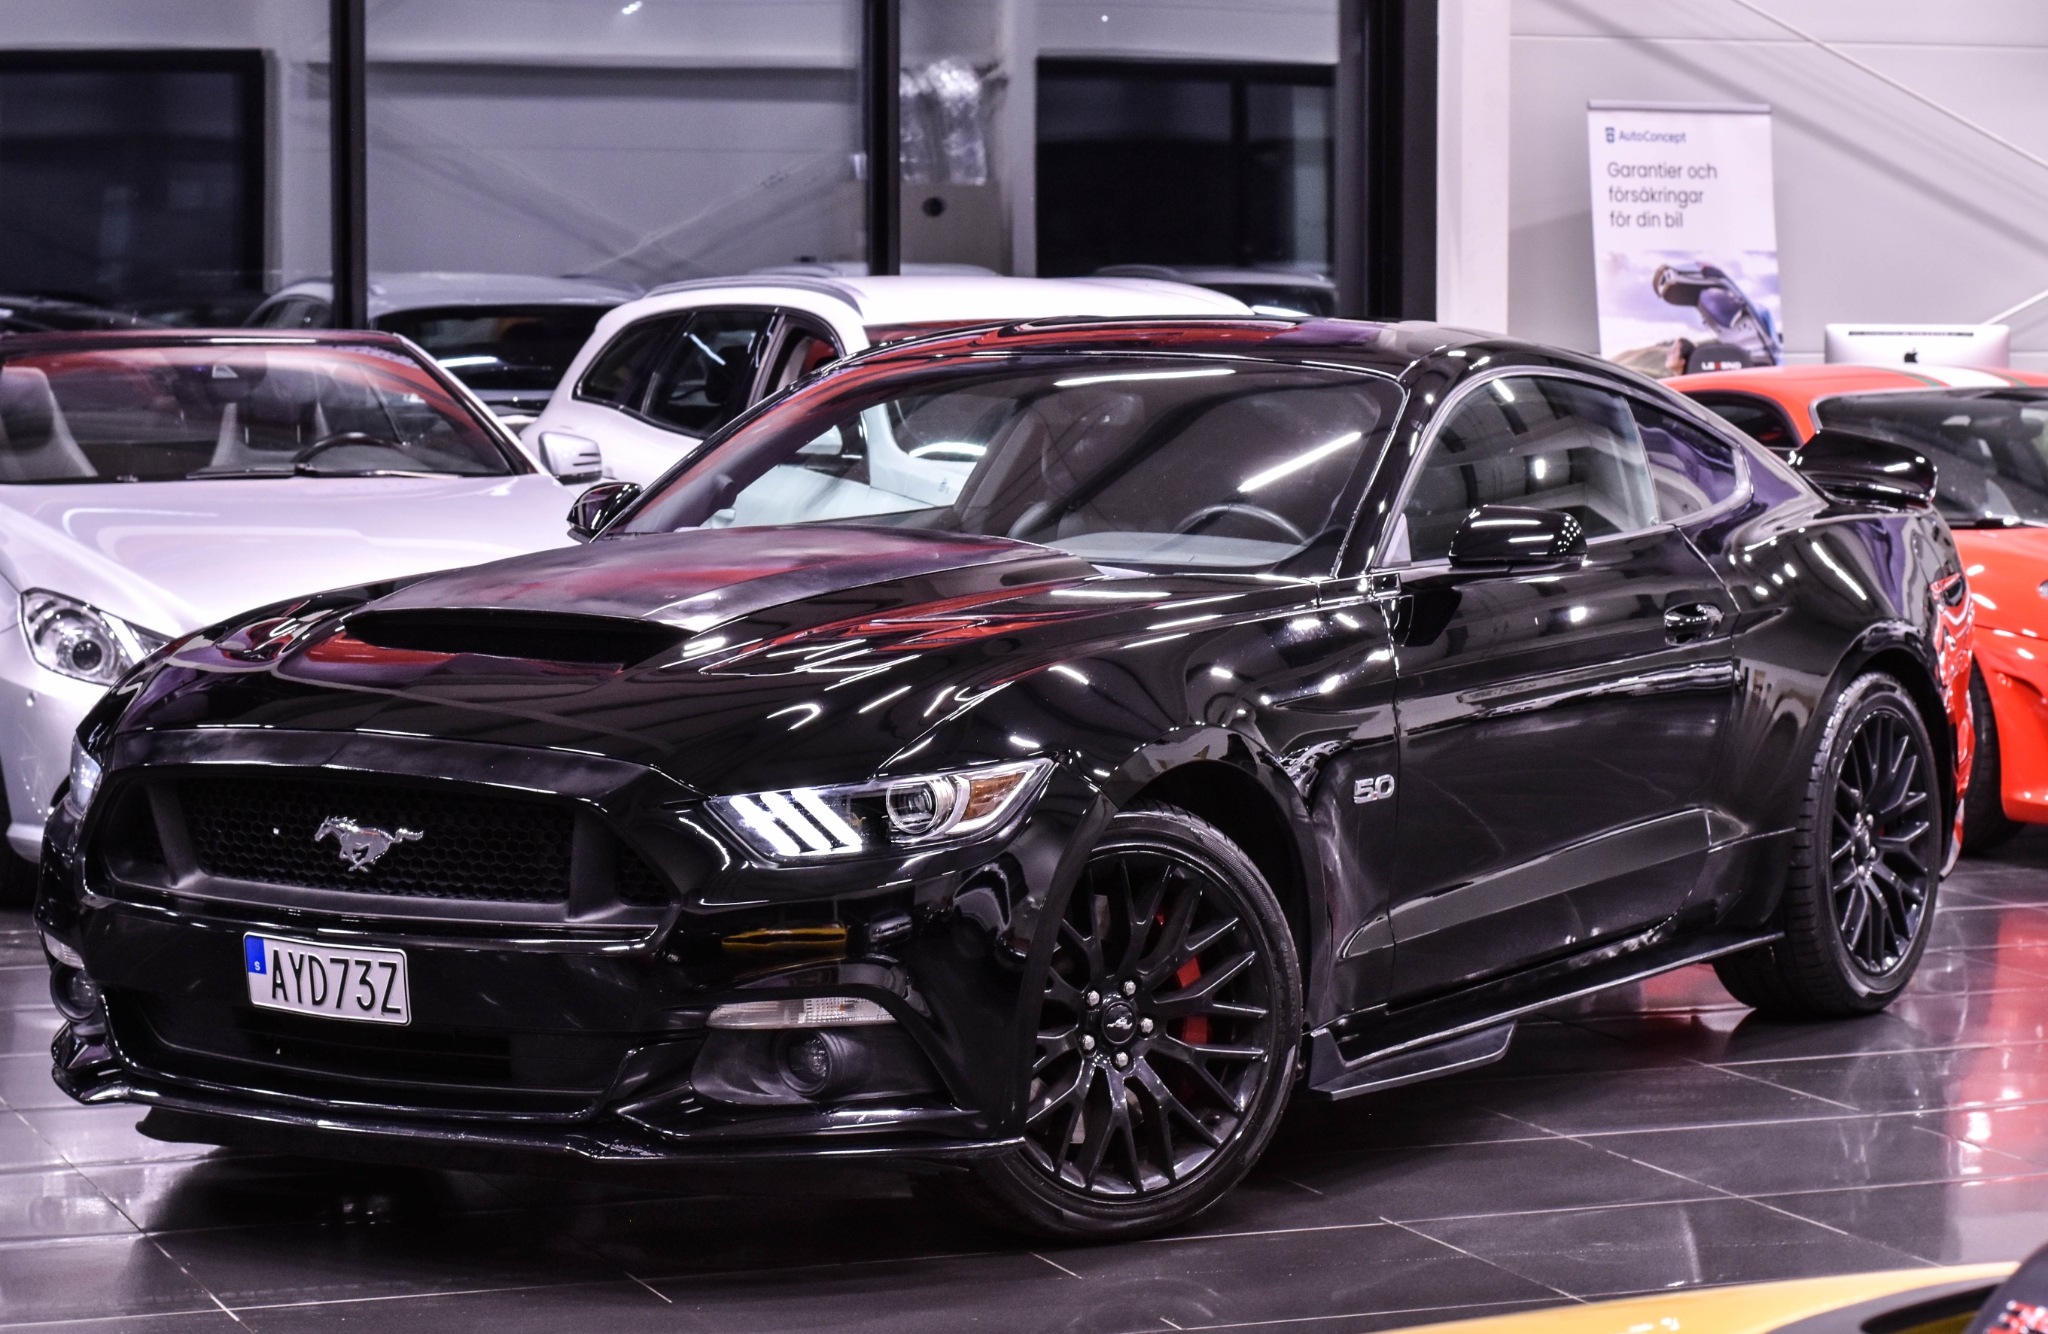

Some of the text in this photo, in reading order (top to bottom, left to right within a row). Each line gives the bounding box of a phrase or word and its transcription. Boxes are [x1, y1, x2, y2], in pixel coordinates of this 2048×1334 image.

[1619, 130, 1686, 144] AutoConcept
[1607, 161, 1718, 179] Garantier och
[1608, 185, 1704, 209] försäkringar
[1609, 210, 1684, 228] för din bil
[1353, 774, 1395, 805] 5.0
[254, 961, 261, 971] S
[272, 949, 402, 1014] AYD73Z
